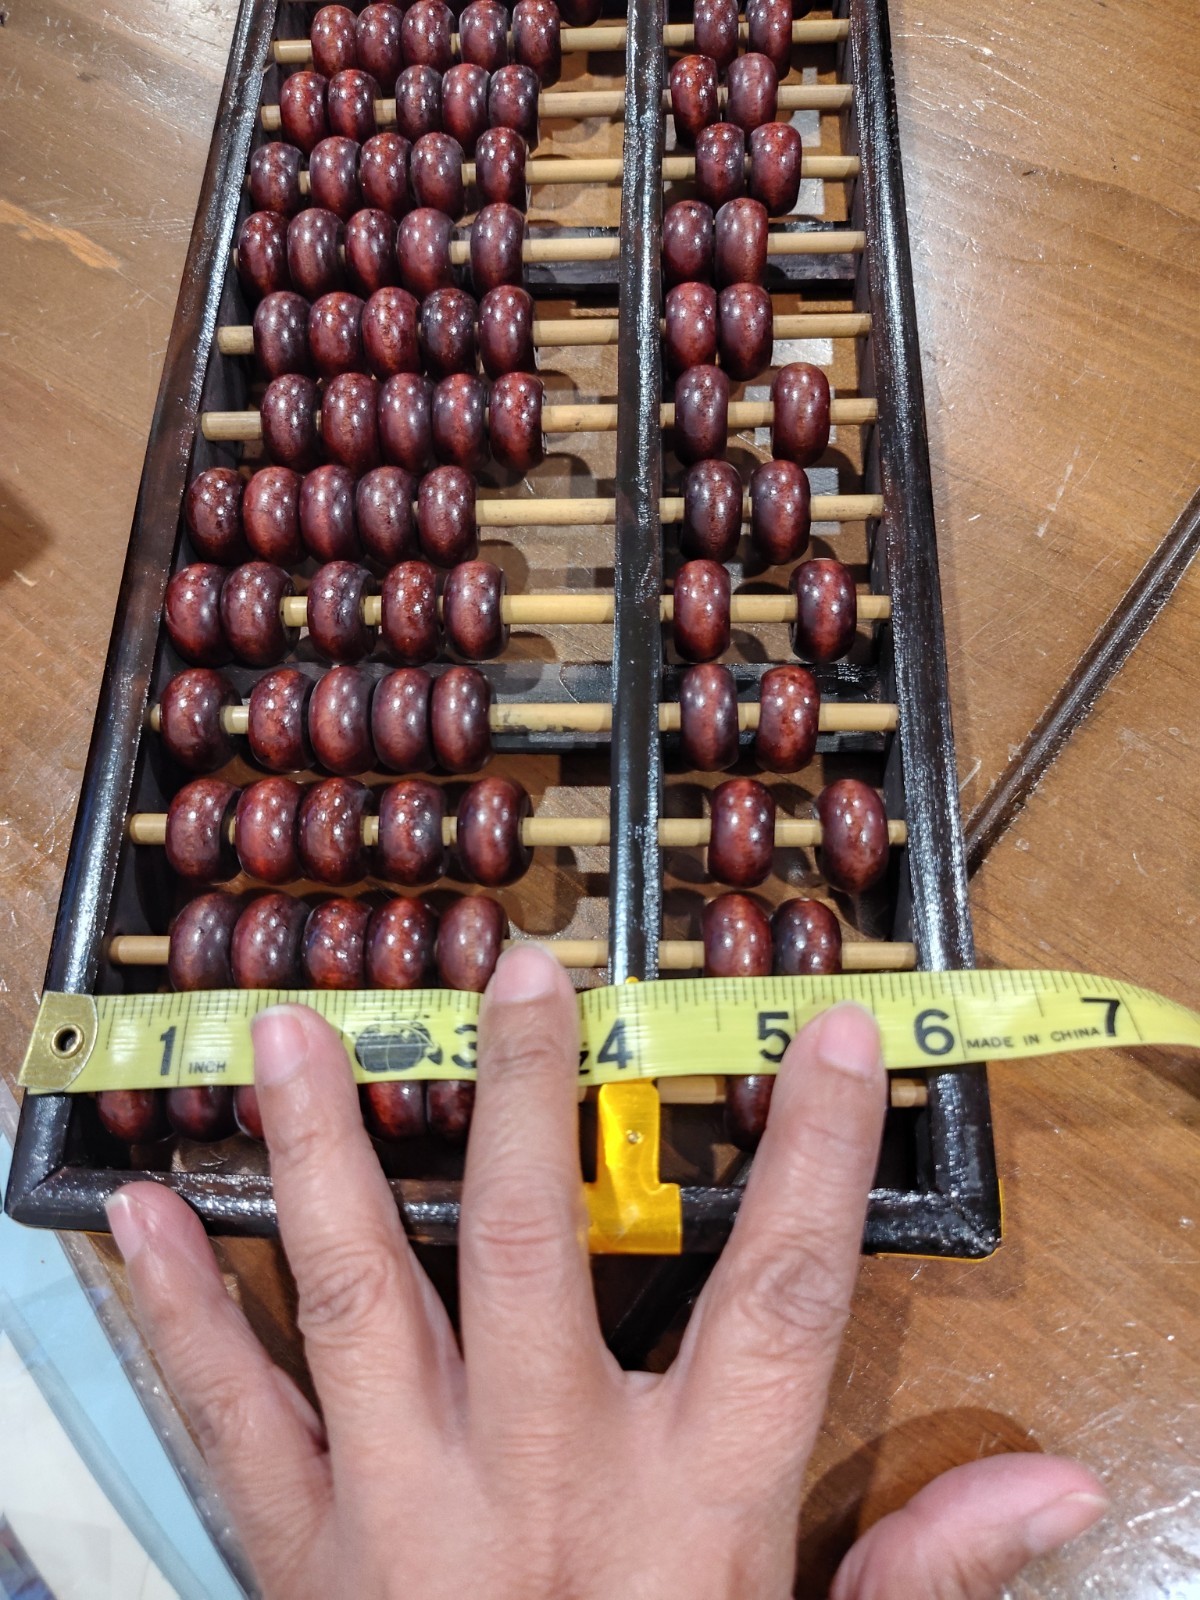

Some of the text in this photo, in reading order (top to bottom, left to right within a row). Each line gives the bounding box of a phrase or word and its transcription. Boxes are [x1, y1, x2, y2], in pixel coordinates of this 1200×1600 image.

[757, 1010, 792, 1063] 5
[913, 1008, 955, 1056] 6
[965, 1026, 1101, 1050] MADE IN CHINA
[1079, 996, 1121, 1038] 7
[159, 1025, 178, 1077] 1
[451, 1023, 478, 1070] 3
[596, 1017, 635, 1070] 4
[187, 1060, 227, 1075] INCH
